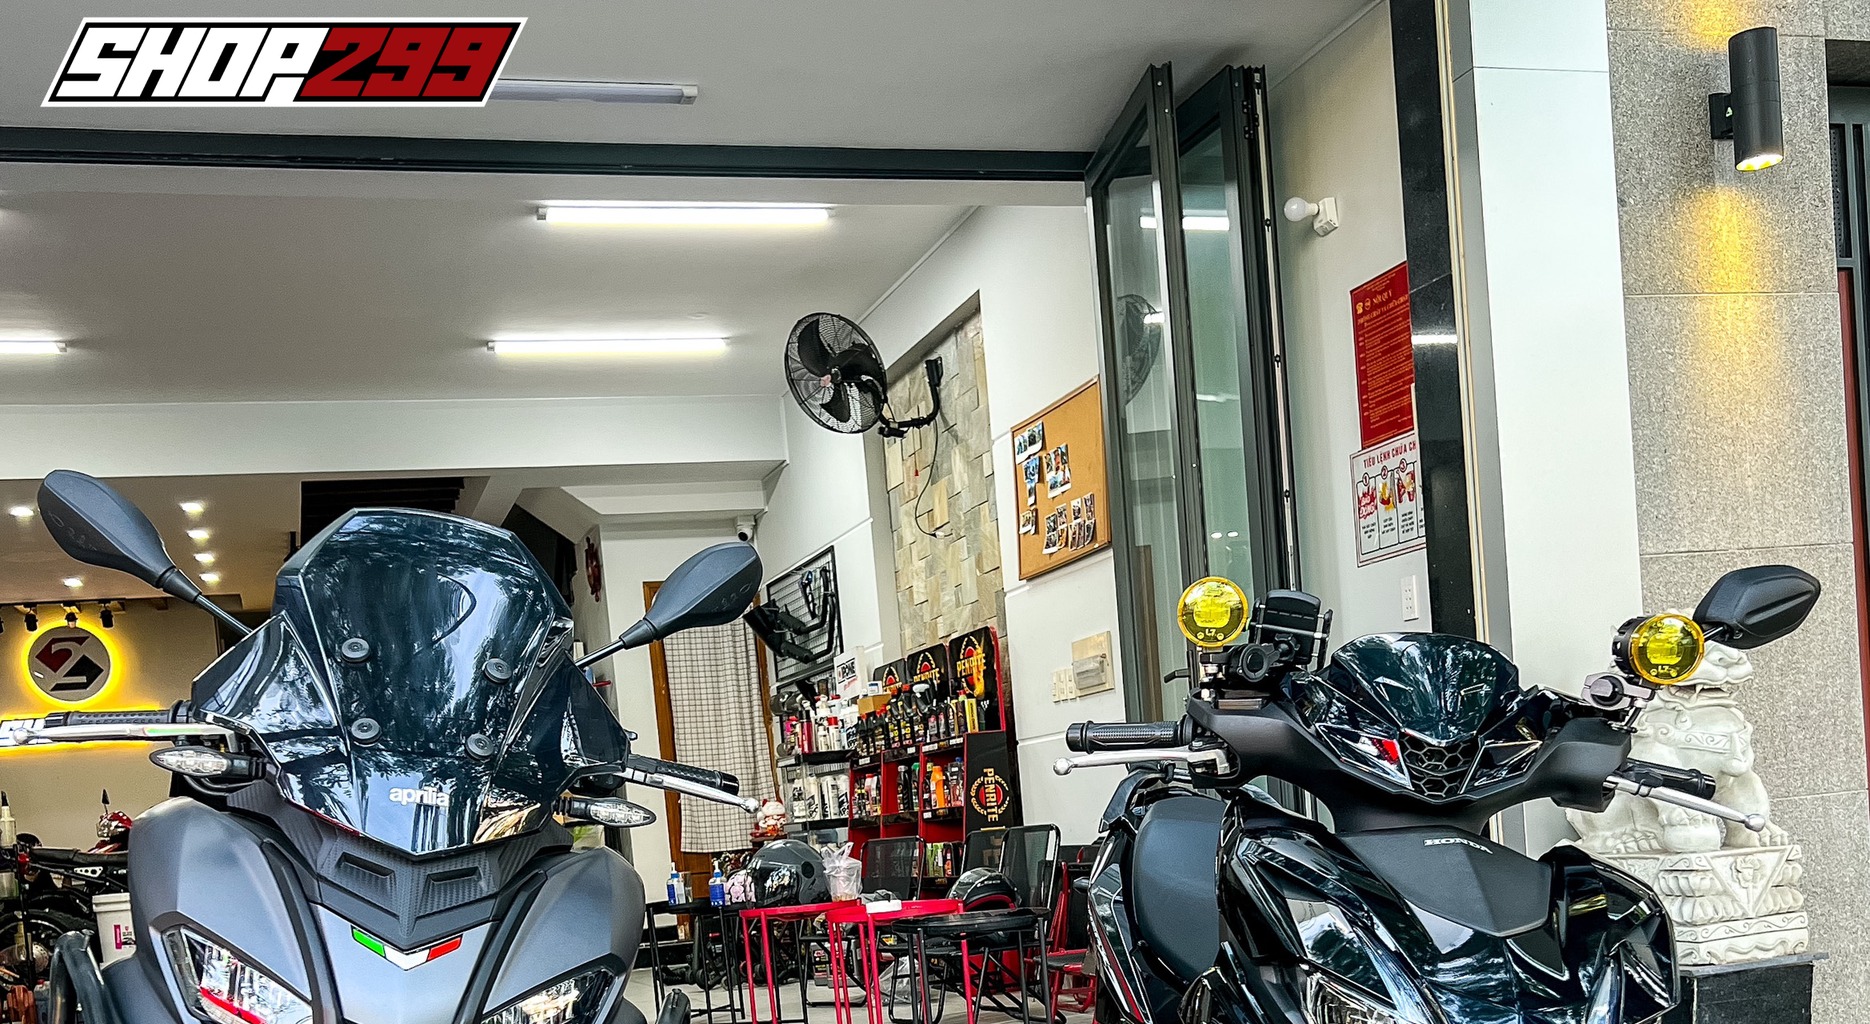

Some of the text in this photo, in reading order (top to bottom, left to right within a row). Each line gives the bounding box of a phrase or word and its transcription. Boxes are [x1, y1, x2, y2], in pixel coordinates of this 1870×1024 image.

[389, 786, 450, 807] aprilia
[983, 768, 999, 822] PENRITE
[1423, 837, 1494, 855] HONDA
